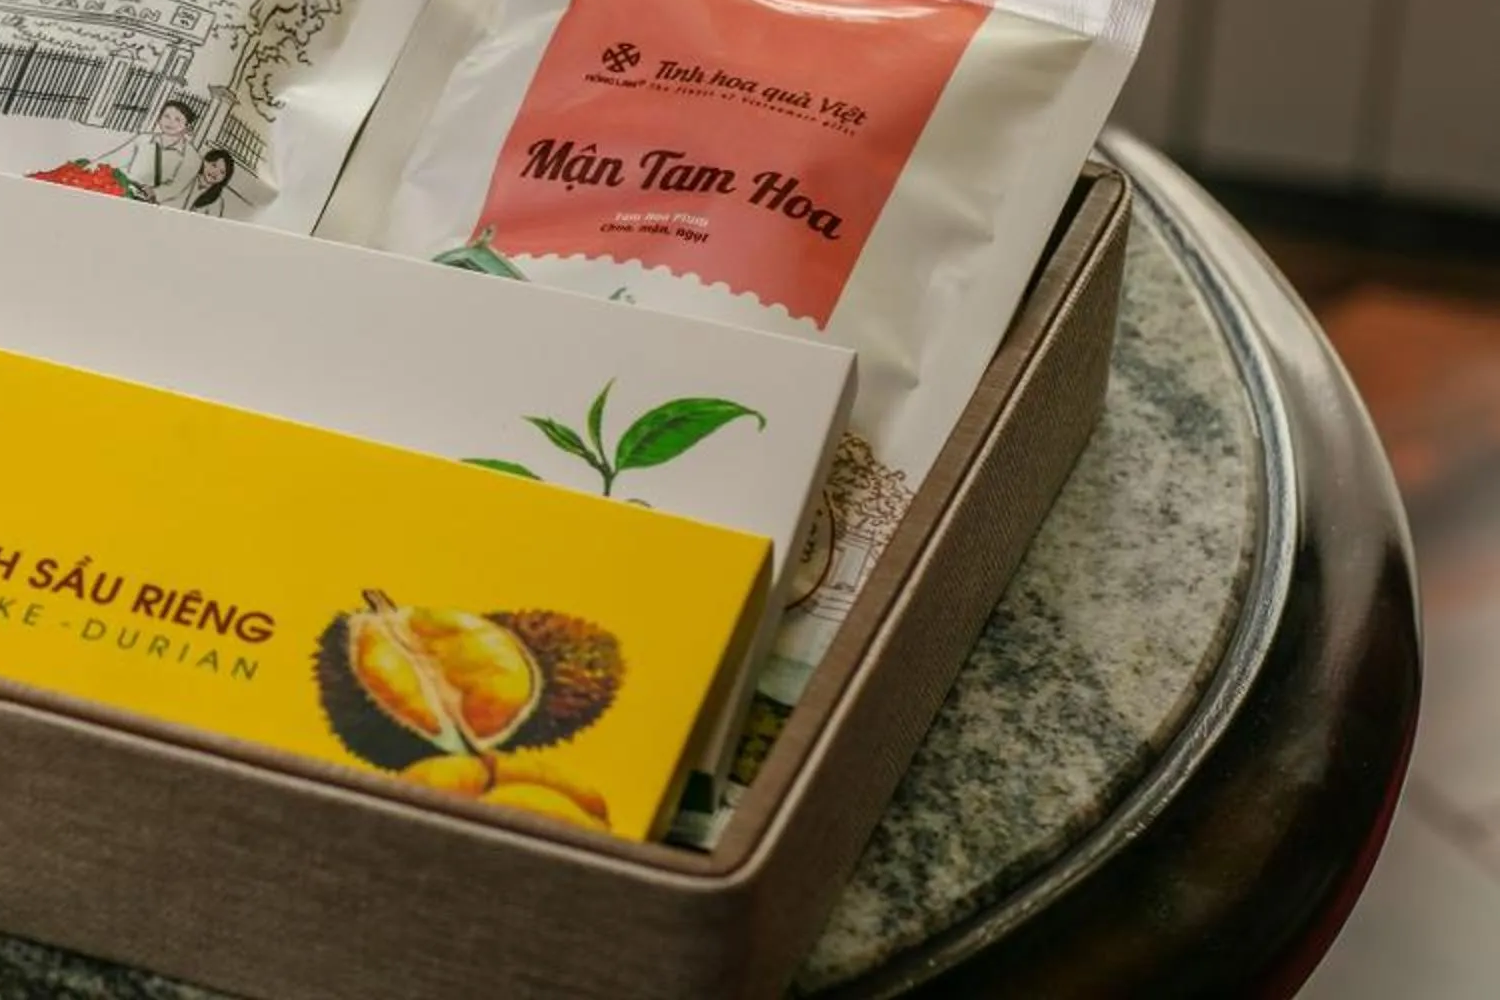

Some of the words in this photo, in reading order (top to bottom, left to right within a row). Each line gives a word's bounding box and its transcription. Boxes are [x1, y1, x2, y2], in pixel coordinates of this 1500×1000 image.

[708, 69, 758, 93] hoa
[762, 85, 812, 108] quà
[820, 96, 867, 125] Việt
[520, 137, 624, 191] Mận
[640, 149, 737, 194] Tam
[747, 170, 844, 240] Hoa
[131, 583, 276, 644] RIÊNG
